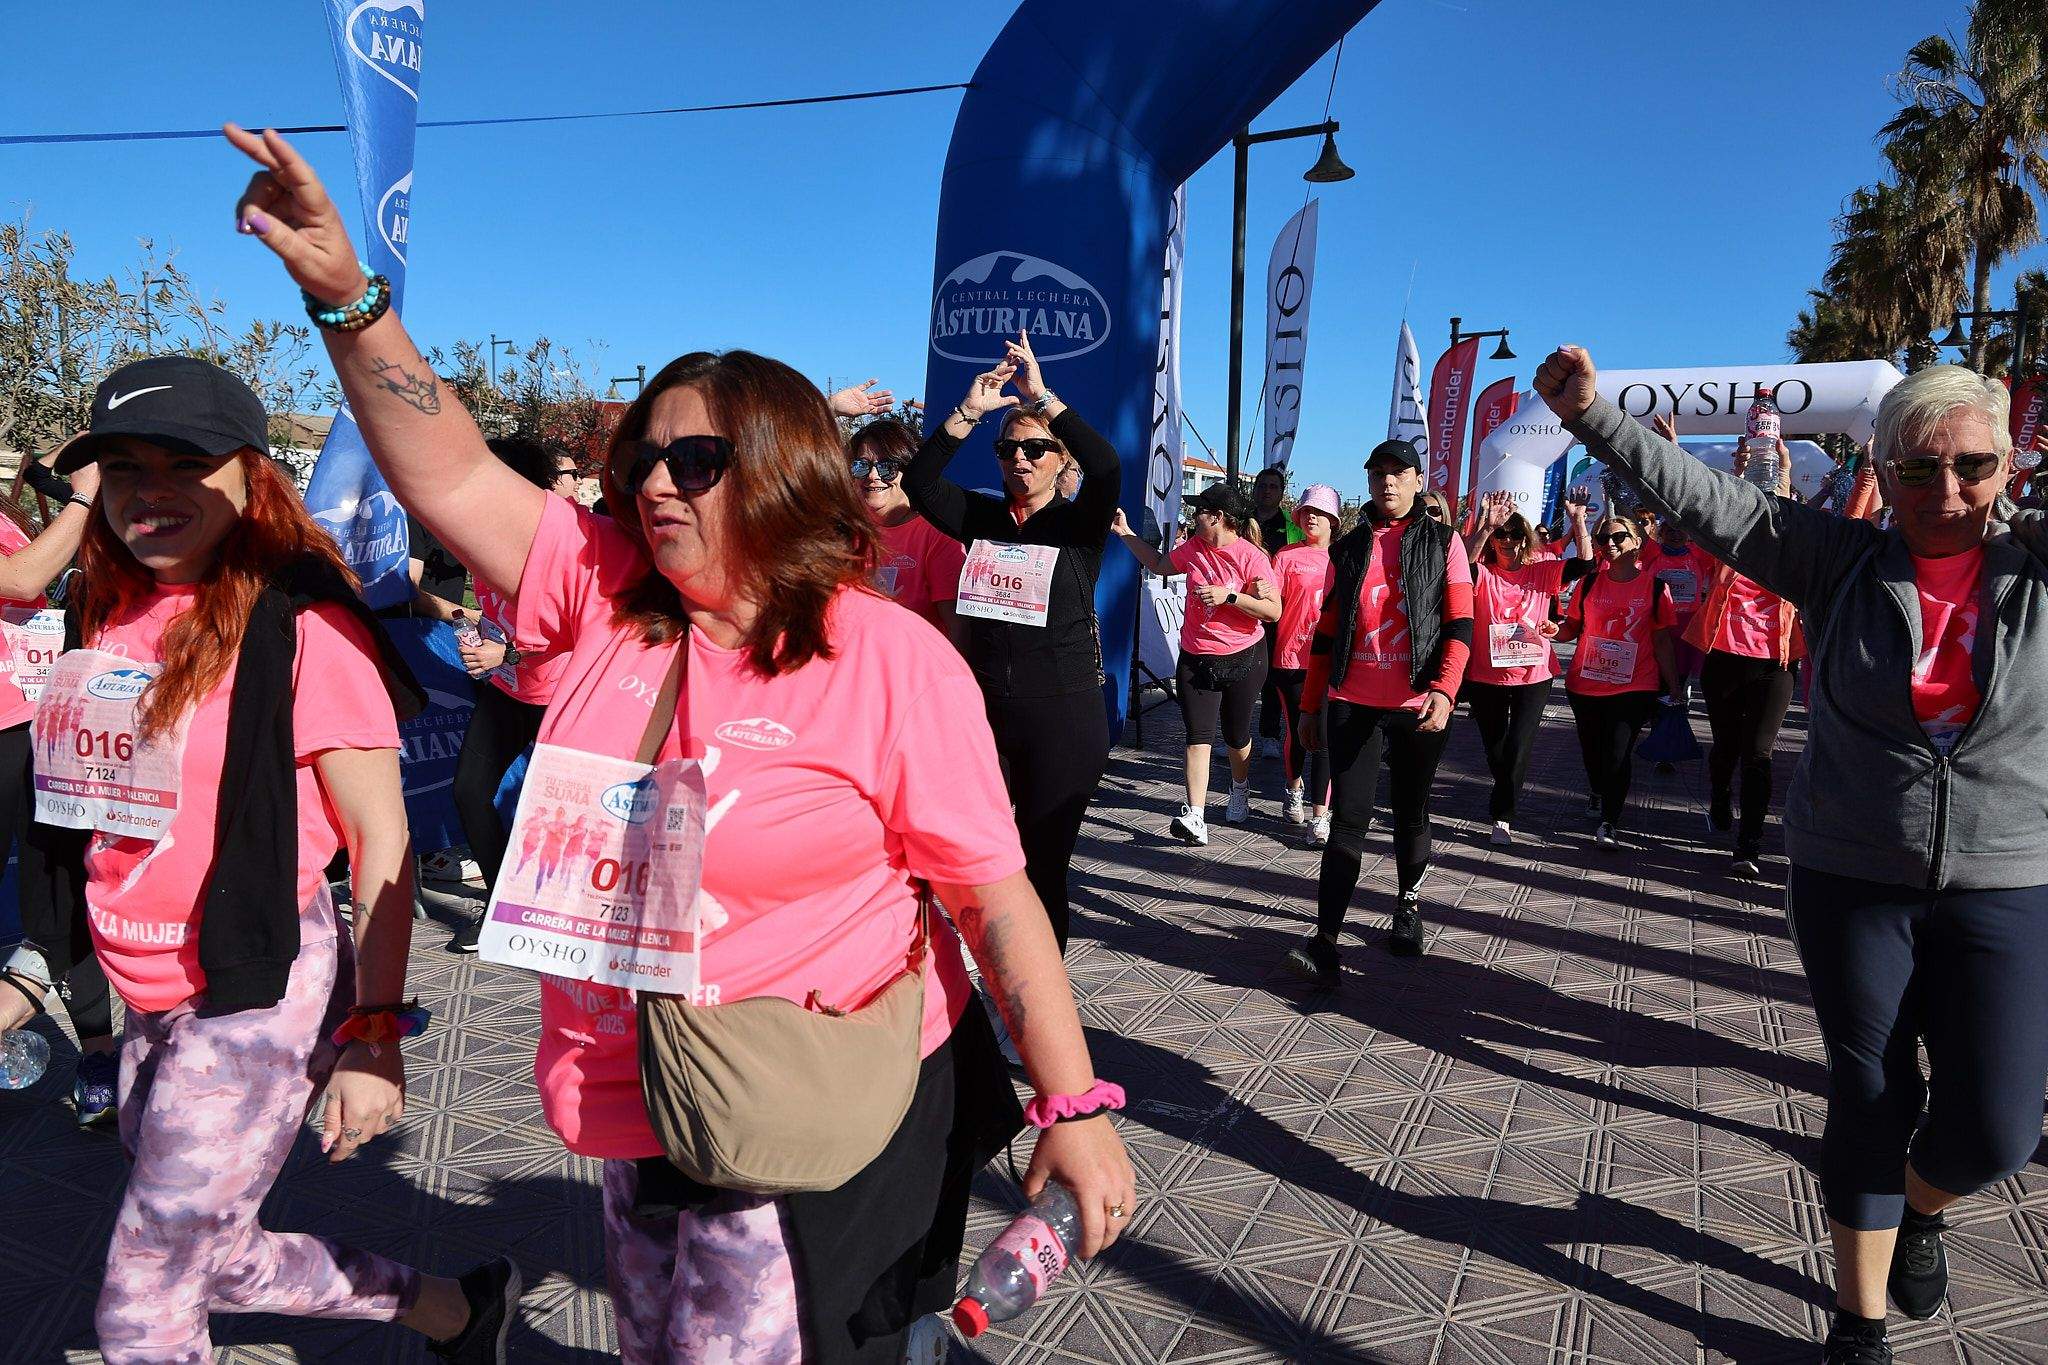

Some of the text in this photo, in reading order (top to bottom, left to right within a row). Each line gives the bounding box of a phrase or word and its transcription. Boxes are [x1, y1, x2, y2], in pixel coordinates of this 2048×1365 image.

[951, 291, 1090, 307] CENTRAL LECHERA
[934, 298, 1095, 341] ASTURIANA
[1618, 379, 1813, 418] OYSHO
[1436, 367, 1463, 461] Santander
[1509, 424, 1562, 436] OYSHO
[990, 574, 1023, 591] 016
[966, 604, 994, 614] OYSHO
[1508, 642, 1528, 651] 016
[1389, 653, 1398, 662] LA
[90, 677, 144, 694] ASTURIAN
[75, 728, 133, 762] 016
[85, 766, 117, 782] 7124
[48, 779, 75, 793] CARRERA
[75, 782, 85, 794] DE
[85, 784, 96, 795] LA
[543, 785, 591, 806] SUMA
[47, 798, 162, 828] OYSHO Santander
[591, 858, 650, 897] 016
[600, 903, 629, 922] 7123
[100, 910, 119, 937] LA
[521, 910, 573, 932] CARRERA
[575, 921, 590, 934] DE
[592, 925, 606, 938] LA
[509, 934, 672, 978] OYSHO Santander
[594, 1014, 626, 1036] 2025
